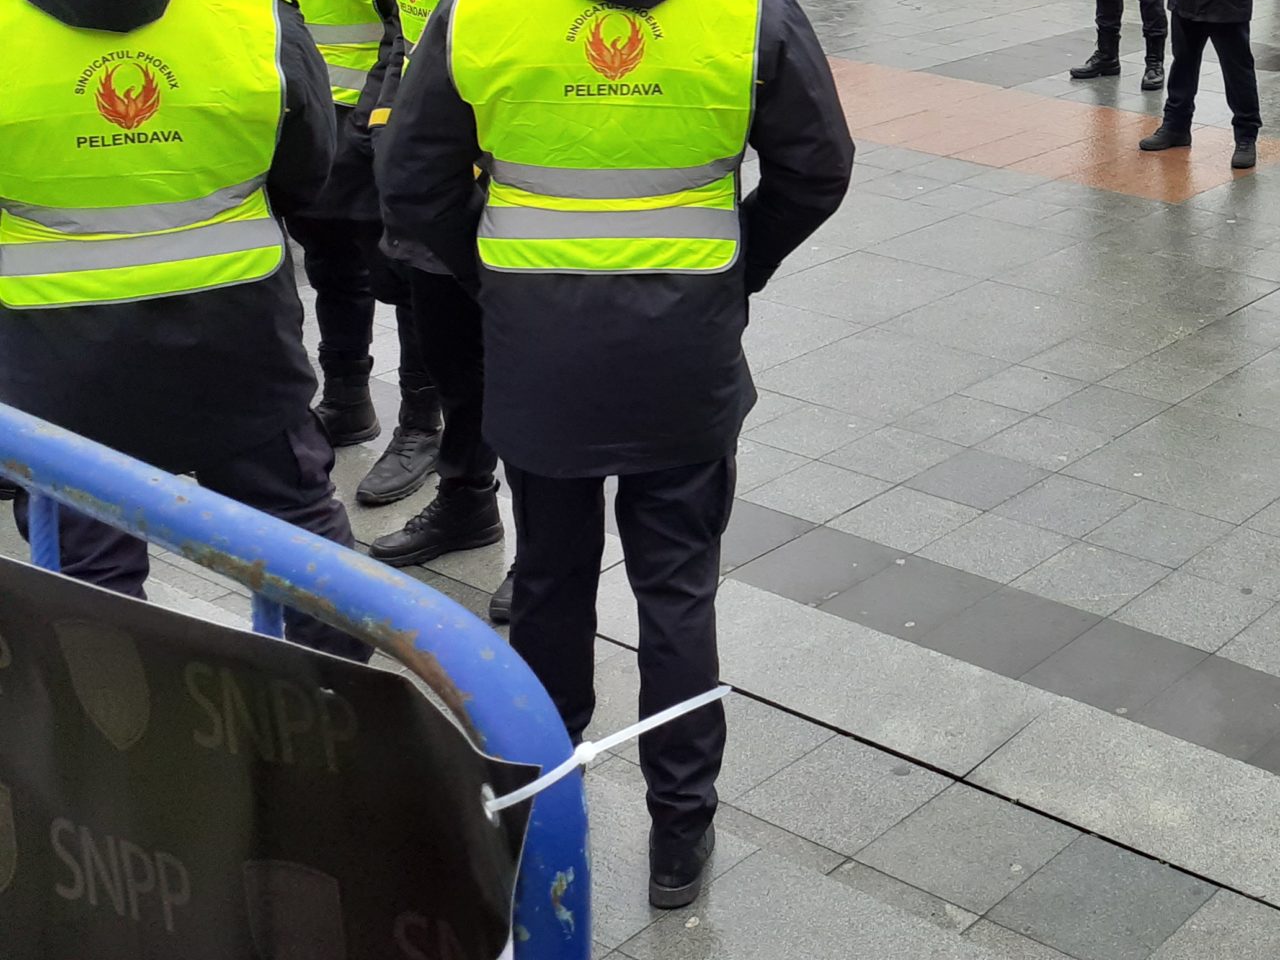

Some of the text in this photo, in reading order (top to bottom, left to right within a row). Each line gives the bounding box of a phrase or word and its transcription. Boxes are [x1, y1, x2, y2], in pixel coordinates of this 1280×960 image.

[74, 50, 180, 95] SINDICATUL PHOENIX
[563, 83, 664, 97] PELENDAVA
[76, 130, 184, 148] PELENDAVA
[184, 660, 358, 774] SNPP
[50, 818, 191, 933] SNPP
